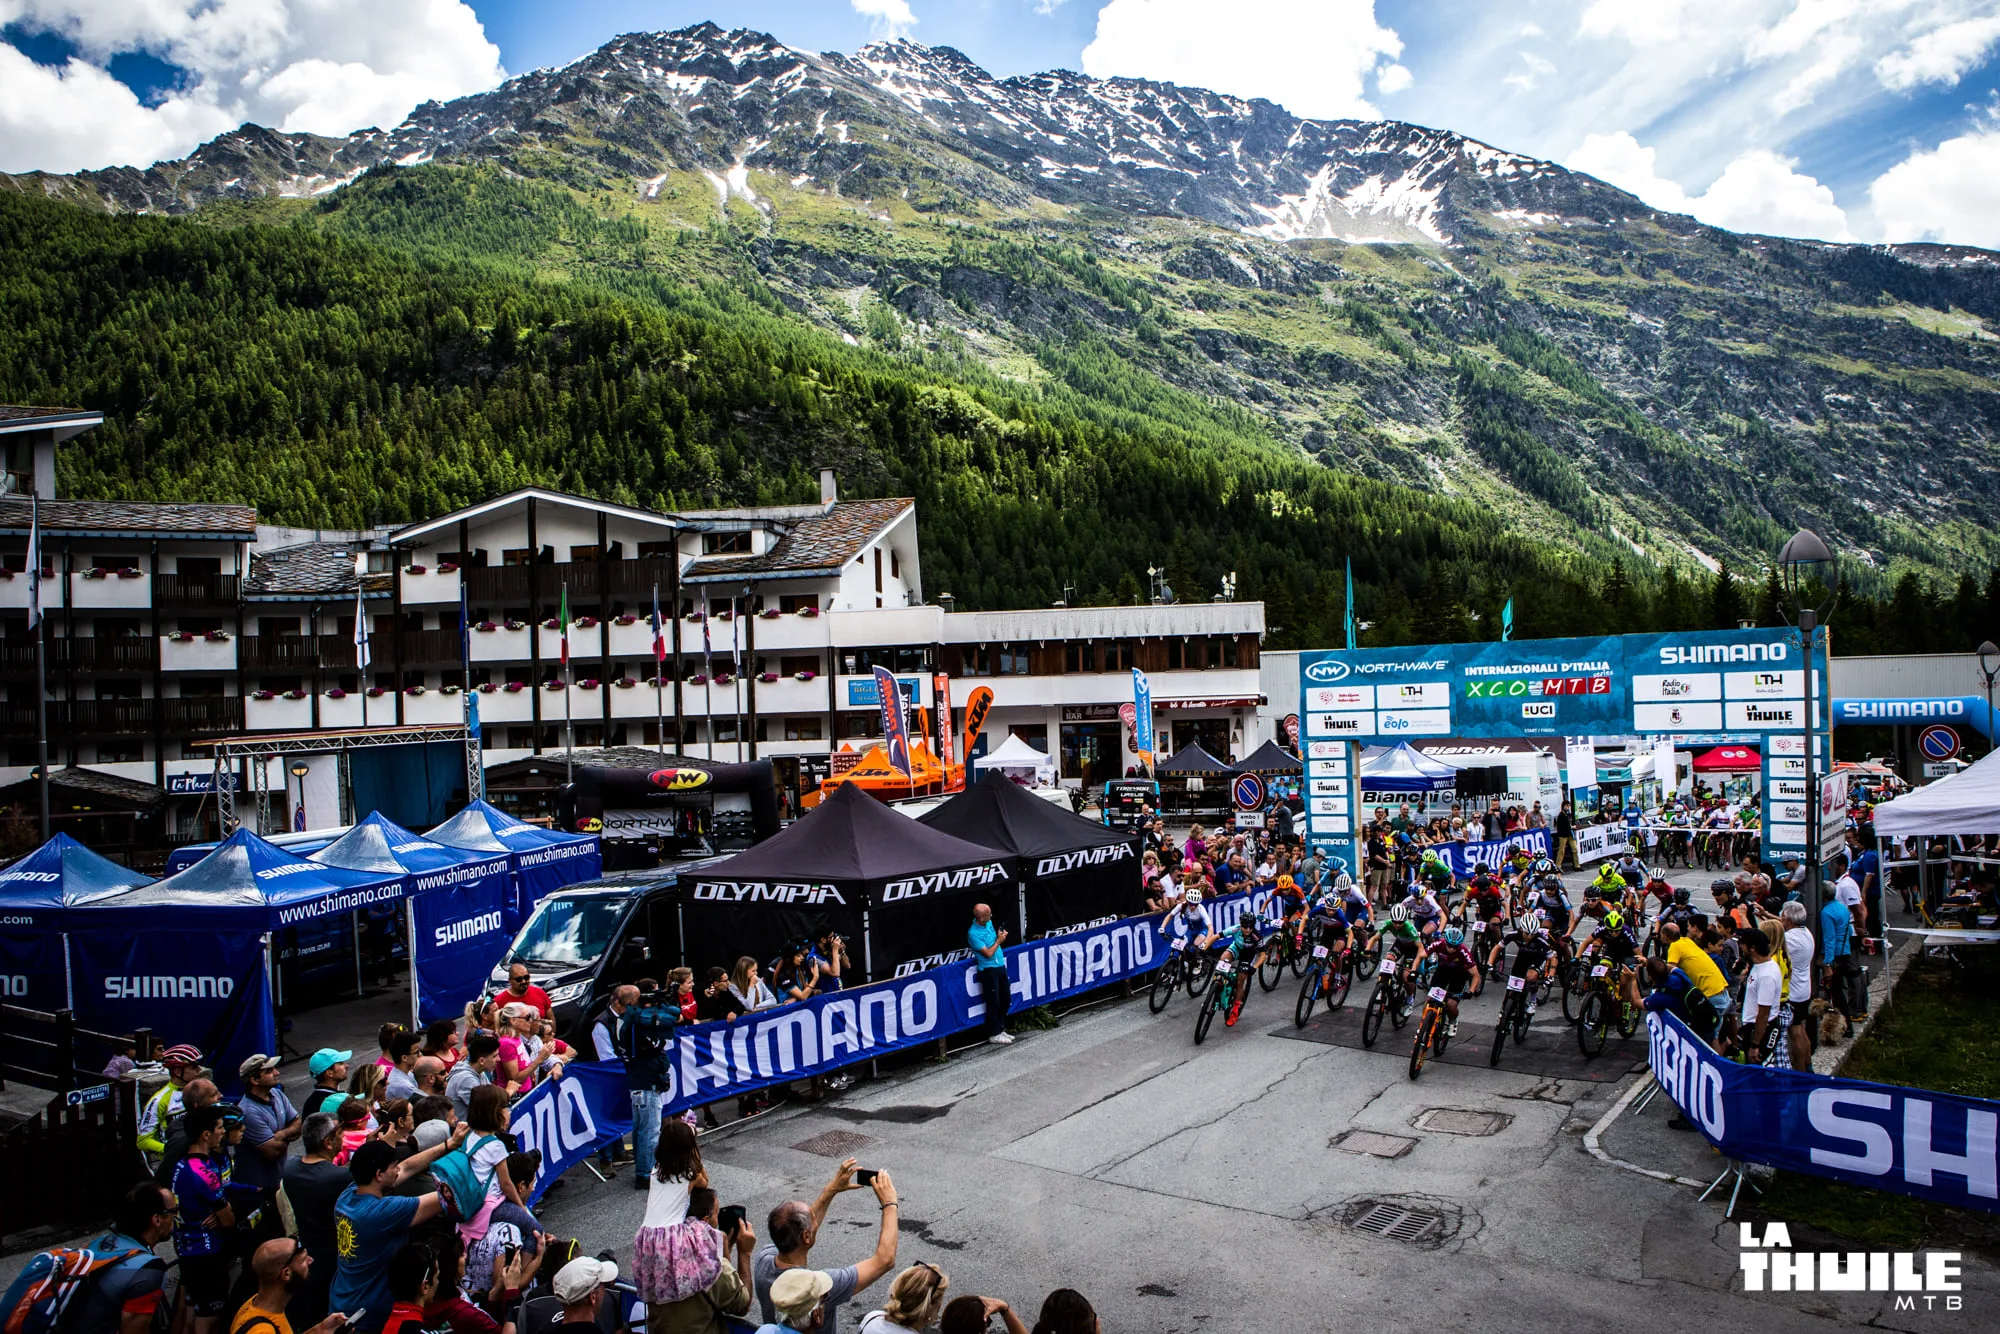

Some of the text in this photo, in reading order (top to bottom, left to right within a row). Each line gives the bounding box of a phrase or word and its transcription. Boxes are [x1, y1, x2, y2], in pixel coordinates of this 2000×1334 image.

[1660, 643, 1786, 664] SHIMANO
[1354, 660, 1446, 674] NORTHWAVE
[1465, 661, 1611, 676] INTERNAZIONALI D'ITALIA
[1662, 679, 1681, 688] Radio
[1755, 674, 1783, 686] LTH
[1400, 686, 1423, 696] LTH
[1662, 687, 1681, 696] Italia
[968, 691, 991, 736] KTM
[1530, 705, 1553, 715] UCI
[1844, 700, 1963, 717] SHIMANO
[1066, 712, 1082, 720] BAR
[1746, 711, 1793, 721] THUILE
[1324, 720, 1358, 730] THUILE
[1421, 745, 1511, 755] Bianchi
[1362, 791, 1439, 804] Bianchi
[1311, 838, 1349, 846] SHIMANO
[519, 842, 596, 868] www.shimano.com
[256, 862, 329, 880] SHIMANO
[416, 857, 508, 892] www.shimano.com
[279, 882, 402, 925] www.shimano.com
[435, 910, 501, 947] SHIMANO
[104, 976, 234, 998] SHIMANO
